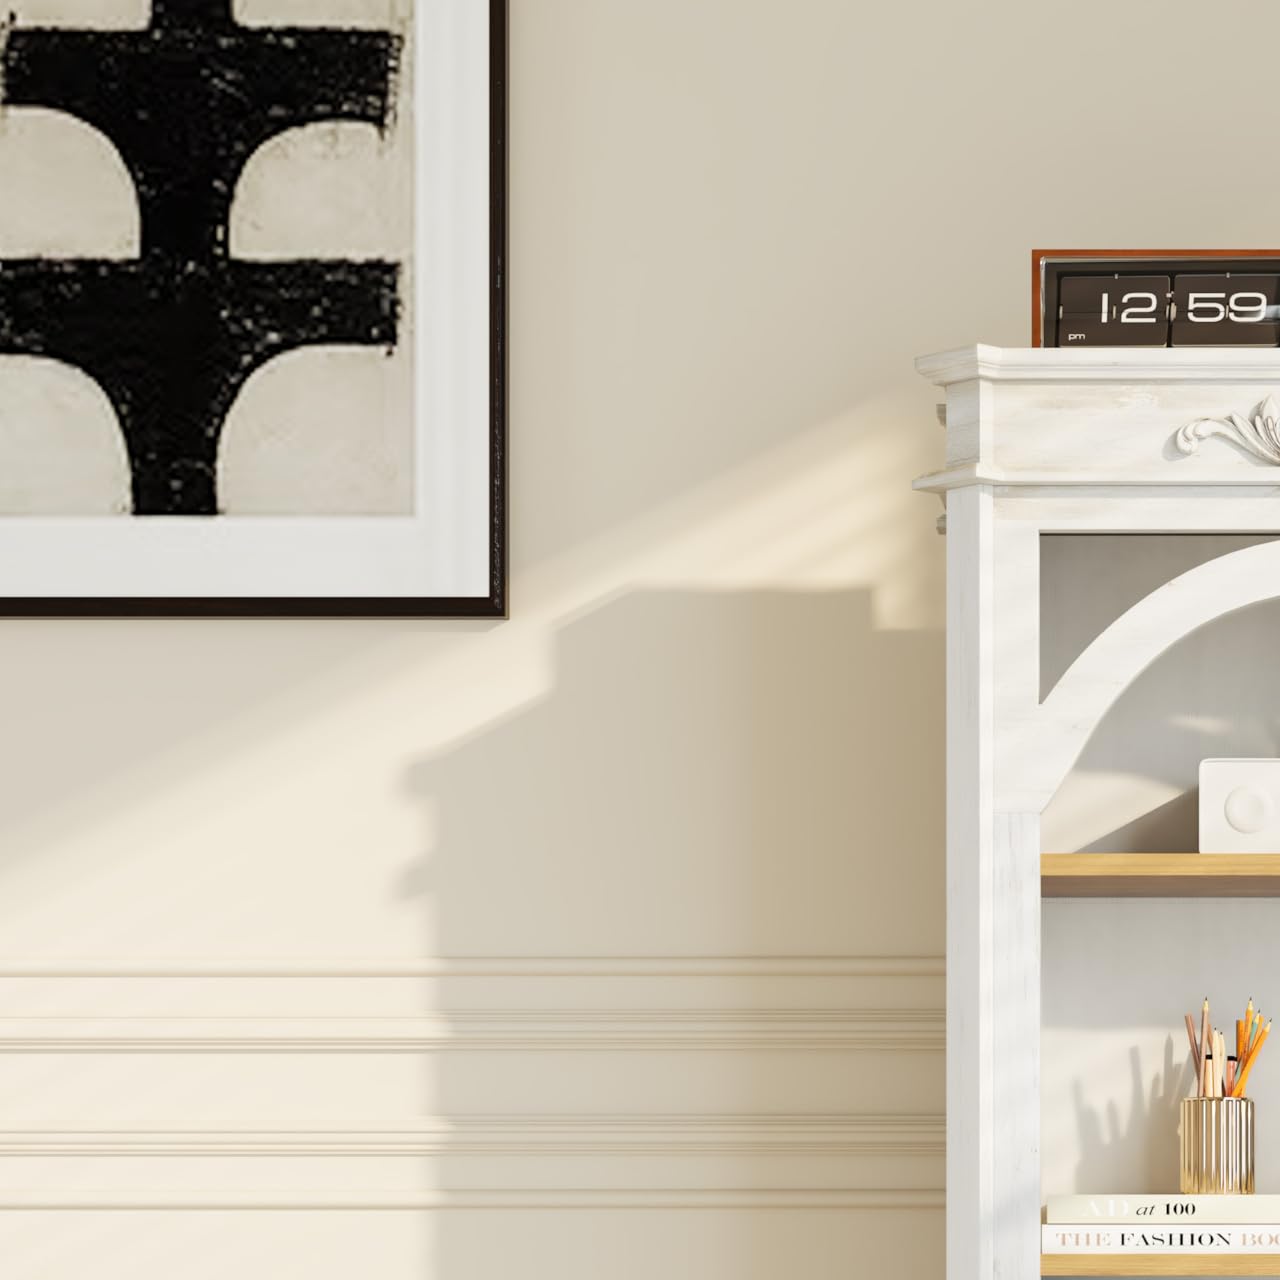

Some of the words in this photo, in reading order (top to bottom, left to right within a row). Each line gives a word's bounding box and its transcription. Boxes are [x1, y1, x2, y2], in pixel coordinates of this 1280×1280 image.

[1101, 292, 1157, 324] 12
[1187, 292, 1267, 323] 59
[1068, 333, 1086, 341] pm
[1136, 1204, 1156, 1216] at
[1165, 1203, 1196, 1216] 100
[1056, 1233, 1111, 1246] THE
[1120, 1233, 1232, 1246] FASHION
